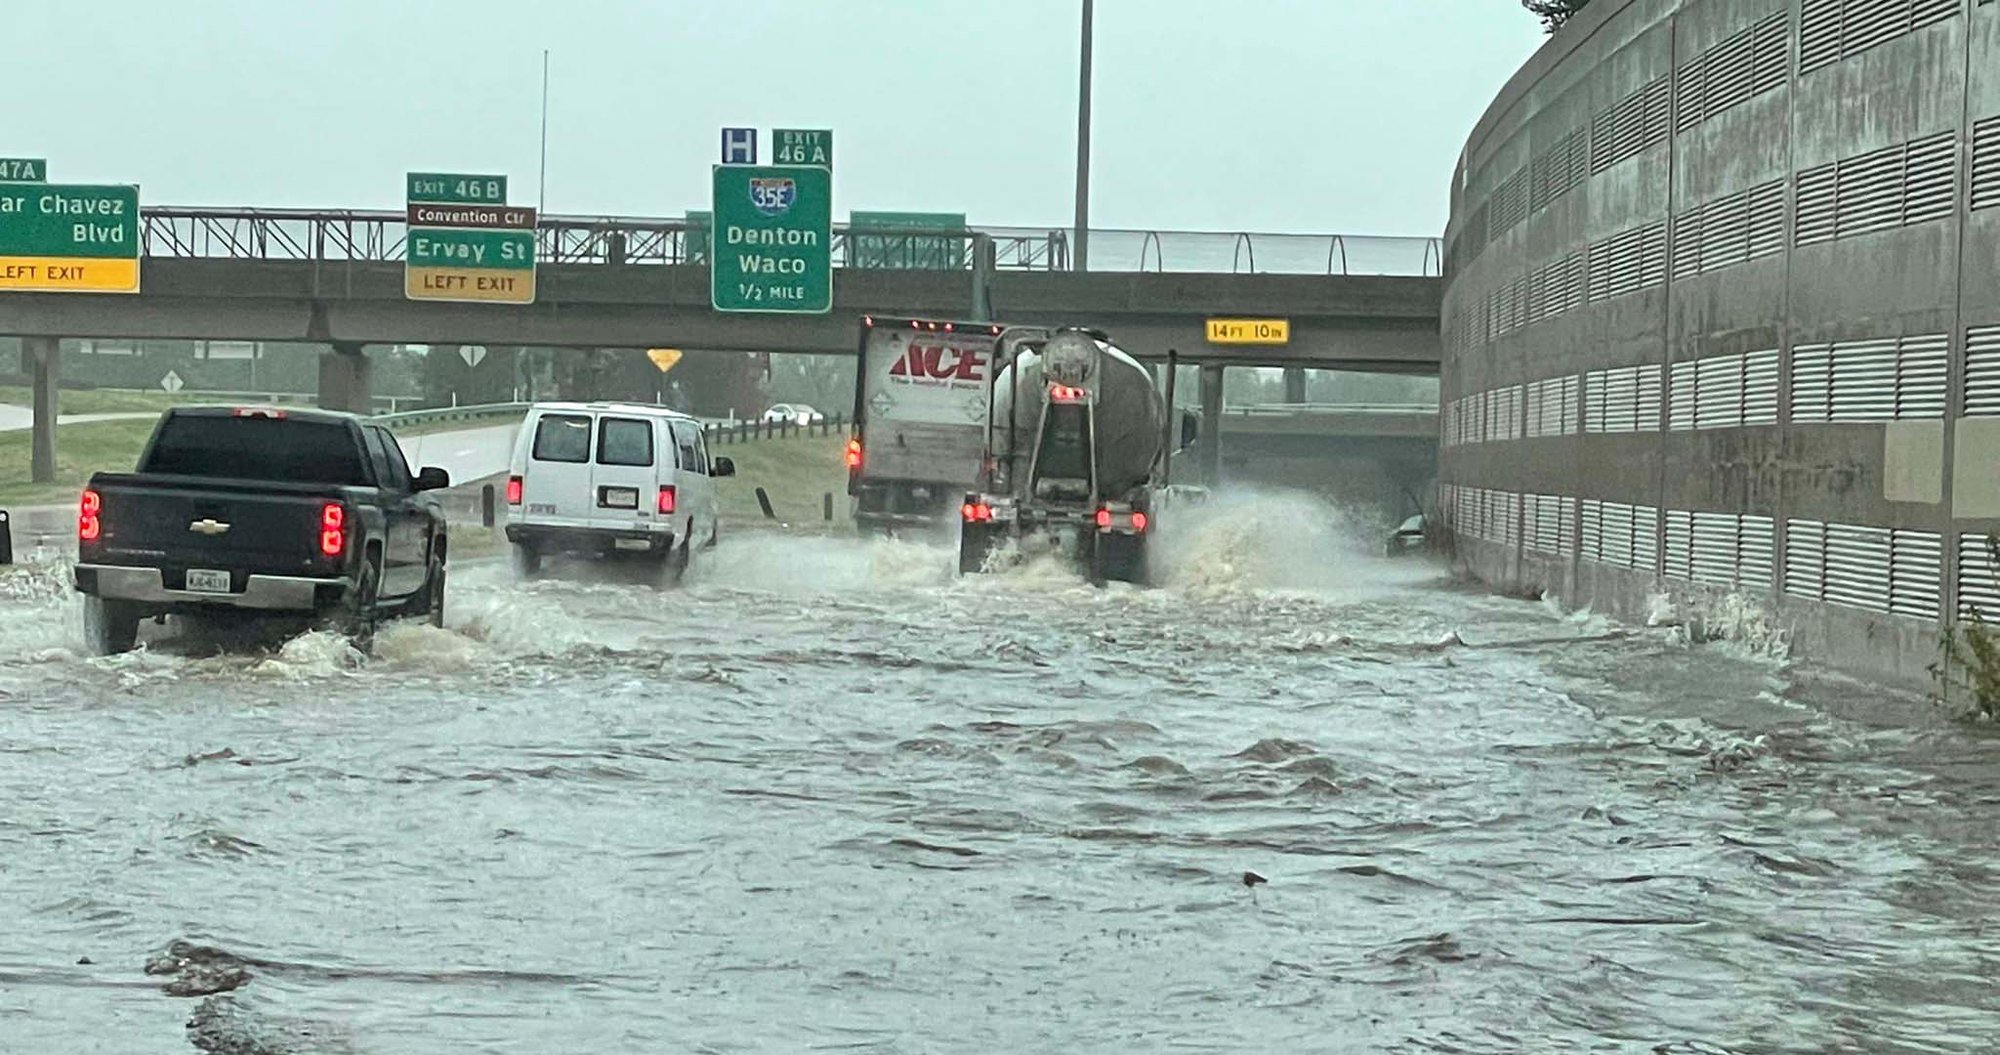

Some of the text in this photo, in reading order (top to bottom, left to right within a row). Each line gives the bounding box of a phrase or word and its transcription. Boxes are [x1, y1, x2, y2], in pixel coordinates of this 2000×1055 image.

[726, 130, 752, 162] H
[783, 132, 821, 145] EXIT
[414, 181, 445, 194] EXIT
[39, 195, 124, 215] Chavez
[756, 187, 788, 208] 35E
[417, 209, 498, 224] Convention
[73, 223, 124, 242] Blvd
[727, 226, 817, 245] Denton
[415, 238, 525, 263] Ervay St
[47, 266, 85, 280] EXIT
[739, 255, 806, 273] Waco
[424, 274, 515, 292] LEFT EXIT
[769, 286, 805, 299] MILE
[889, 344, 987, 380] ACE
